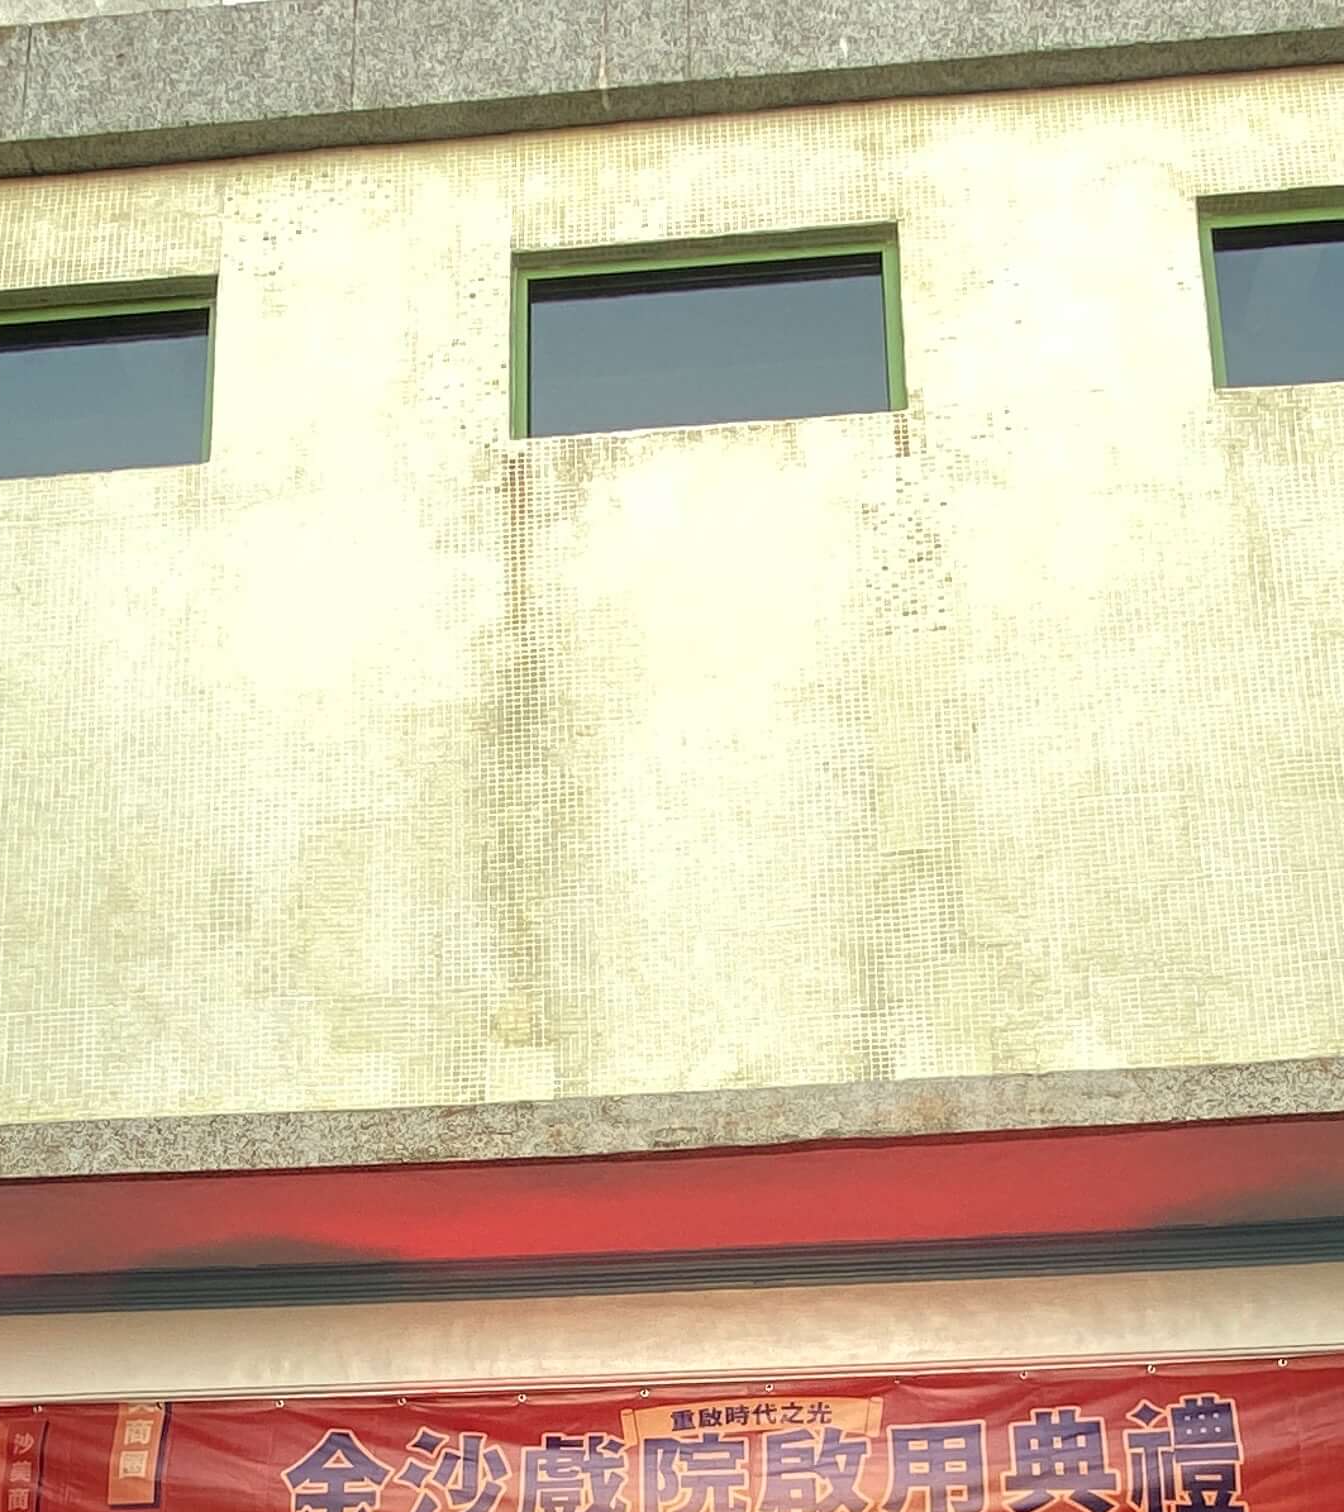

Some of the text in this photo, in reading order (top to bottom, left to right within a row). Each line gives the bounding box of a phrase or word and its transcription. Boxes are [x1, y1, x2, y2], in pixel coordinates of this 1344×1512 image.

[119, 1403, 156, 1480] 商圈
[670, 1401, 833, 1432] 重啟時代之光
